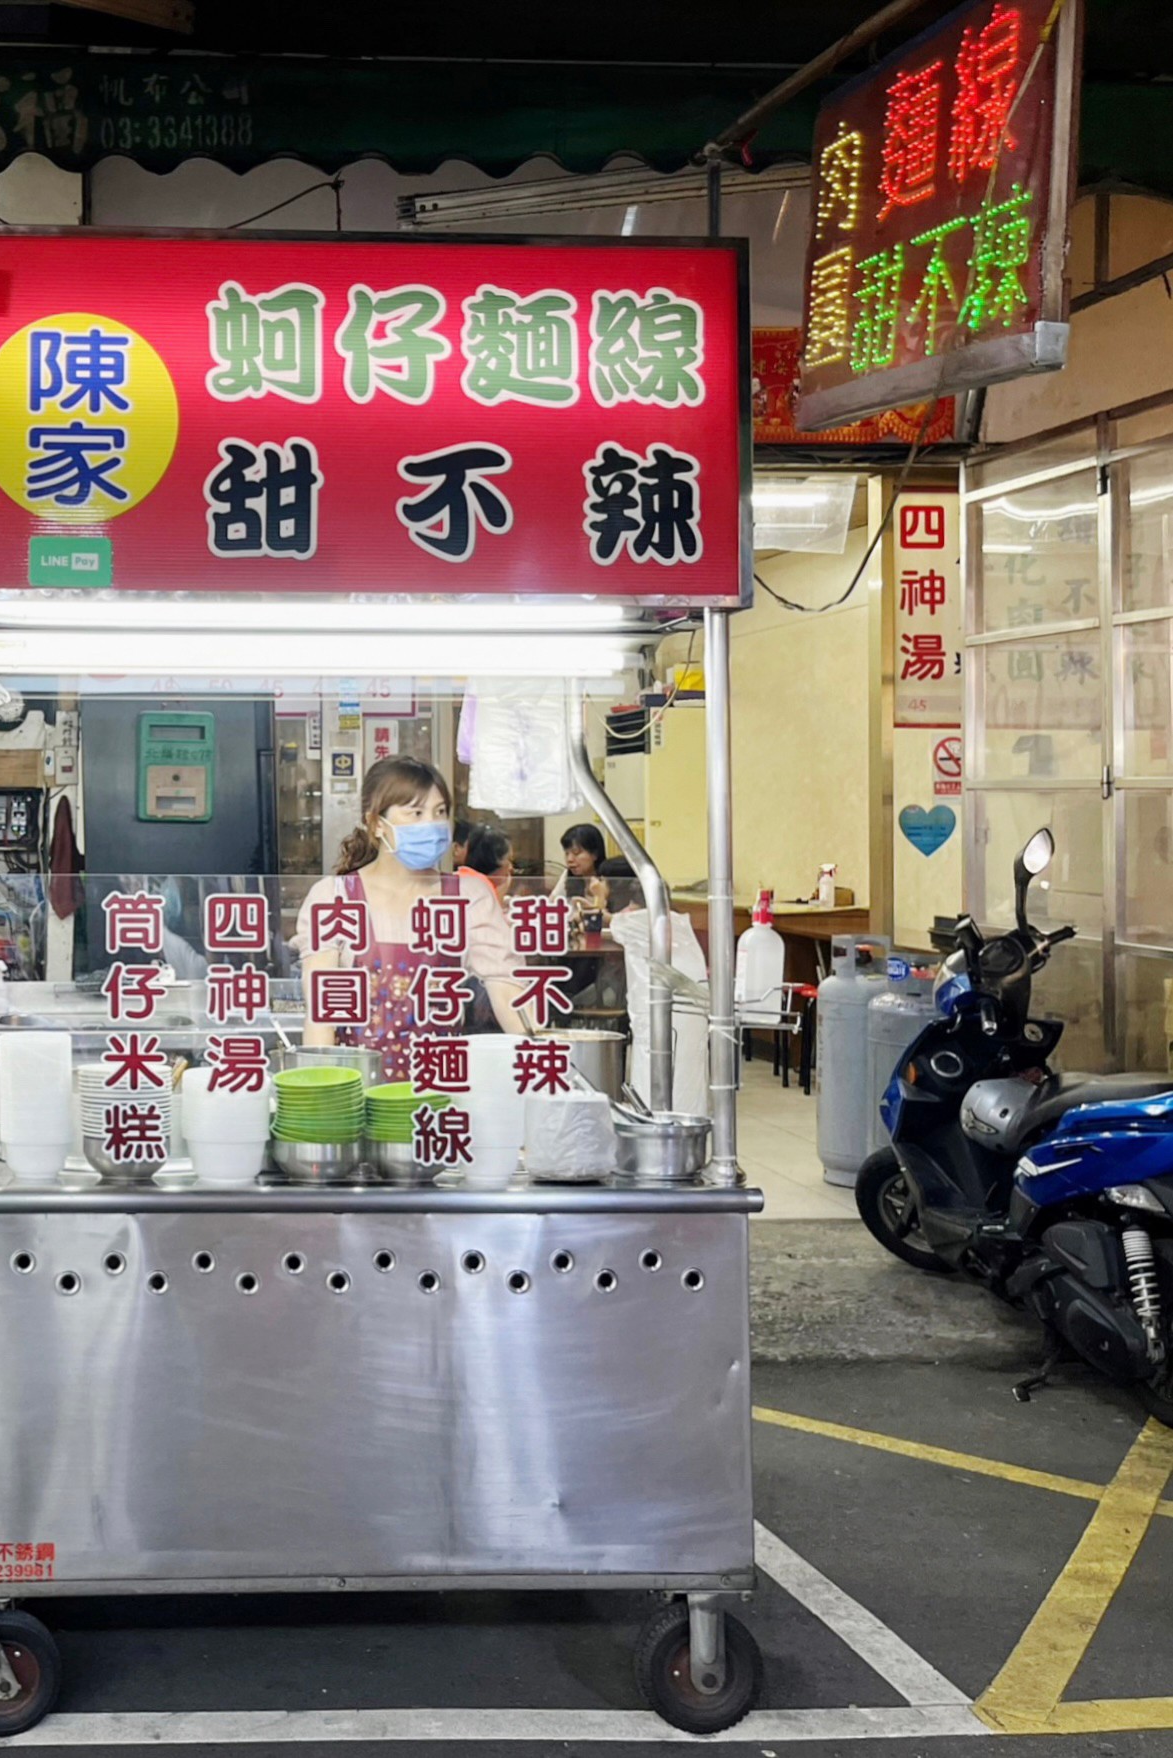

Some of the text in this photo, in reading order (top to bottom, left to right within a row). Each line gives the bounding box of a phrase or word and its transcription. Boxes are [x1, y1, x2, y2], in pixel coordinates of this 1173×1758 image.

[27, 329, 133, 508] 陳家
[206, 280, 705, 408] 蚵仔麵線
[40, 555, 96, 568] LINE Pay
[203, 436, 702, 566] 甜不辣
[900, 505, 946, 681] 四神湯
[101, 890, 168, 1165] 筒仔米糕
[205, 893, 270, 1096] 四神湯
[309, 895, 372, 1027] 肉圓
[409, 896, 475, 1167] 蚵仔麵線
[510, 896, 572, 1096] 甜不辣
